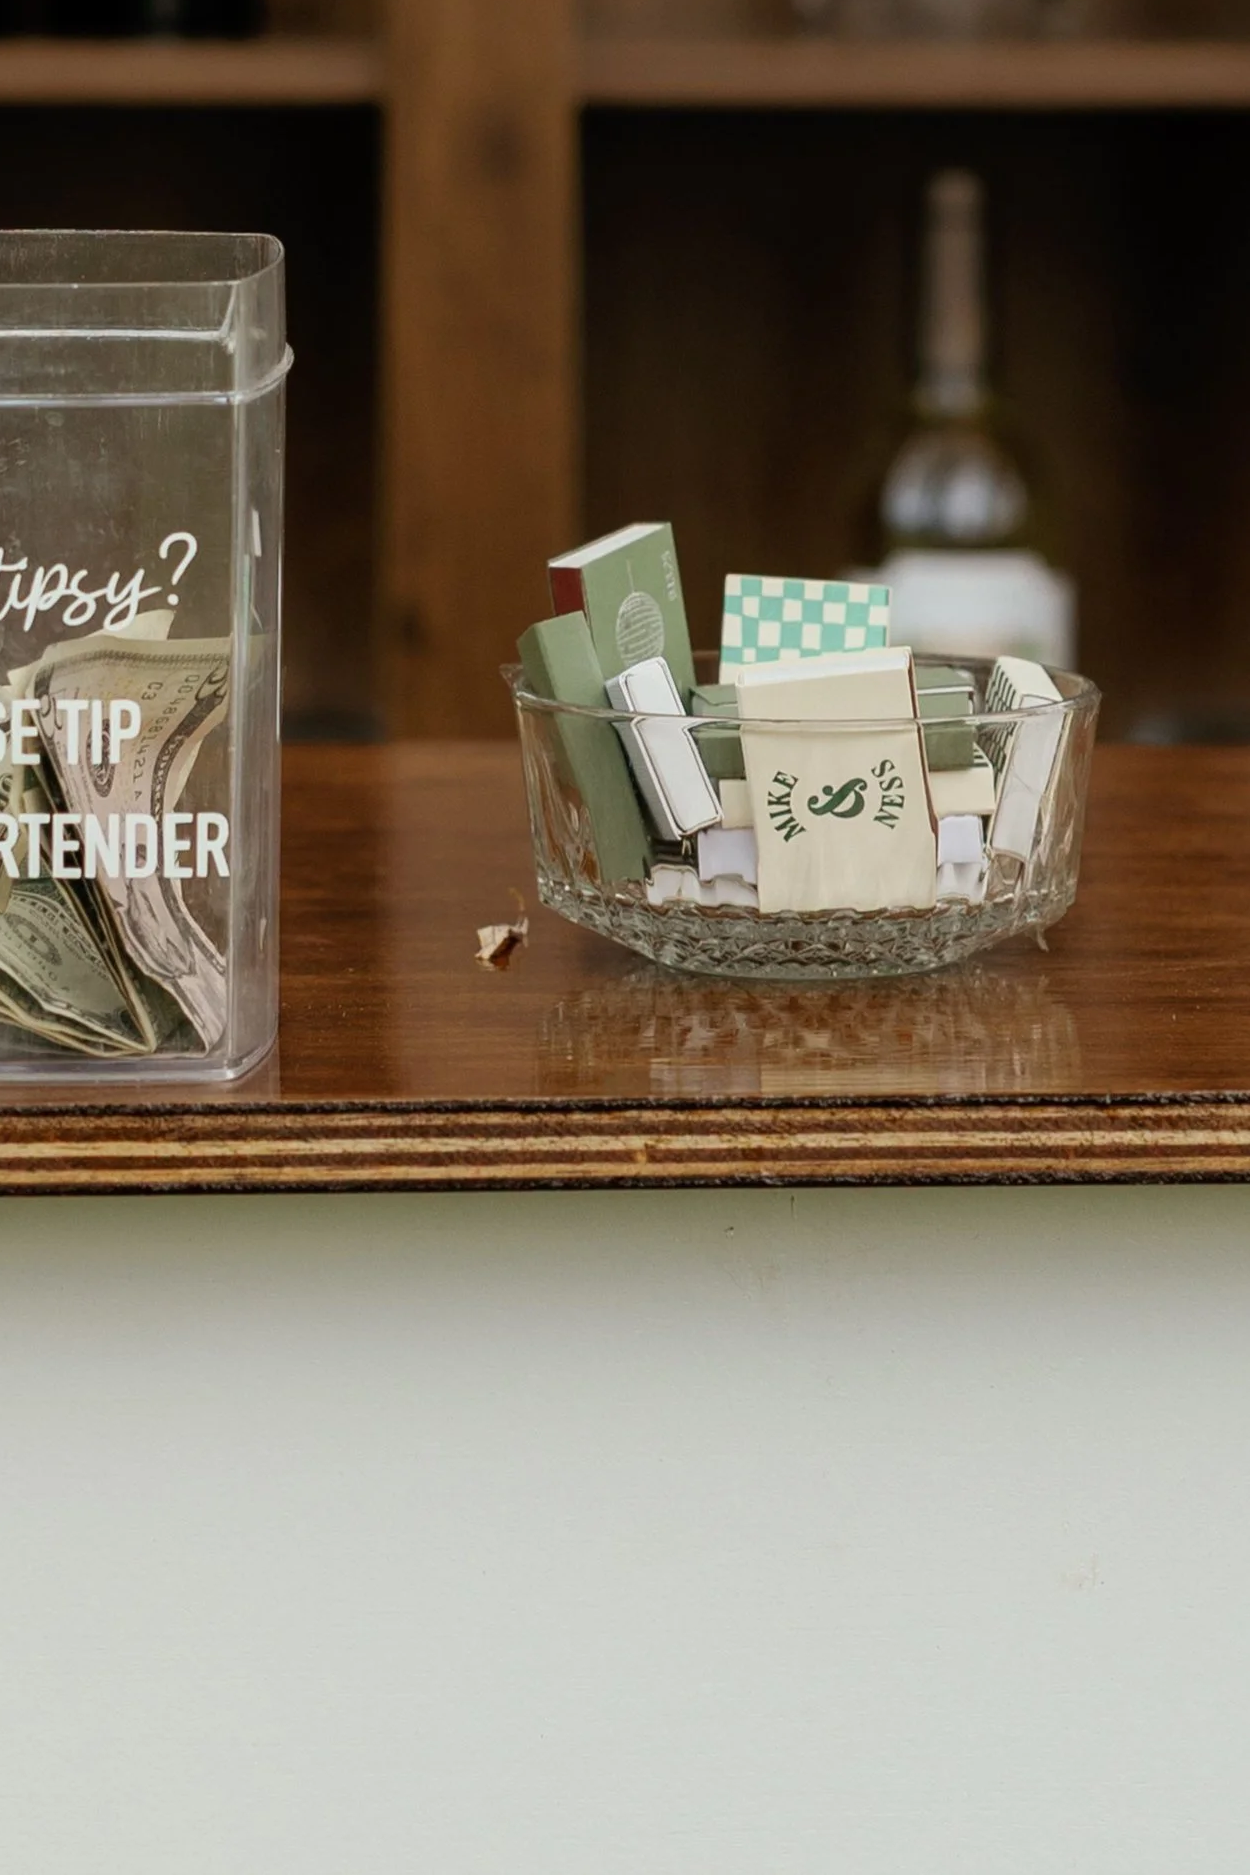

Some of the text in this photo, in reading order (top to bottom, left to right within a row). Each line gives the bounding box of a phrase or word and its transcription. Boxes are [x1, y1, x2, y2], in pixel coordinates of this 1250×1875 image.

[56, 698, 142, 766] TIP
[767, 770, 807, 843] MIKE
[871, 759, 906, 830] NESS
